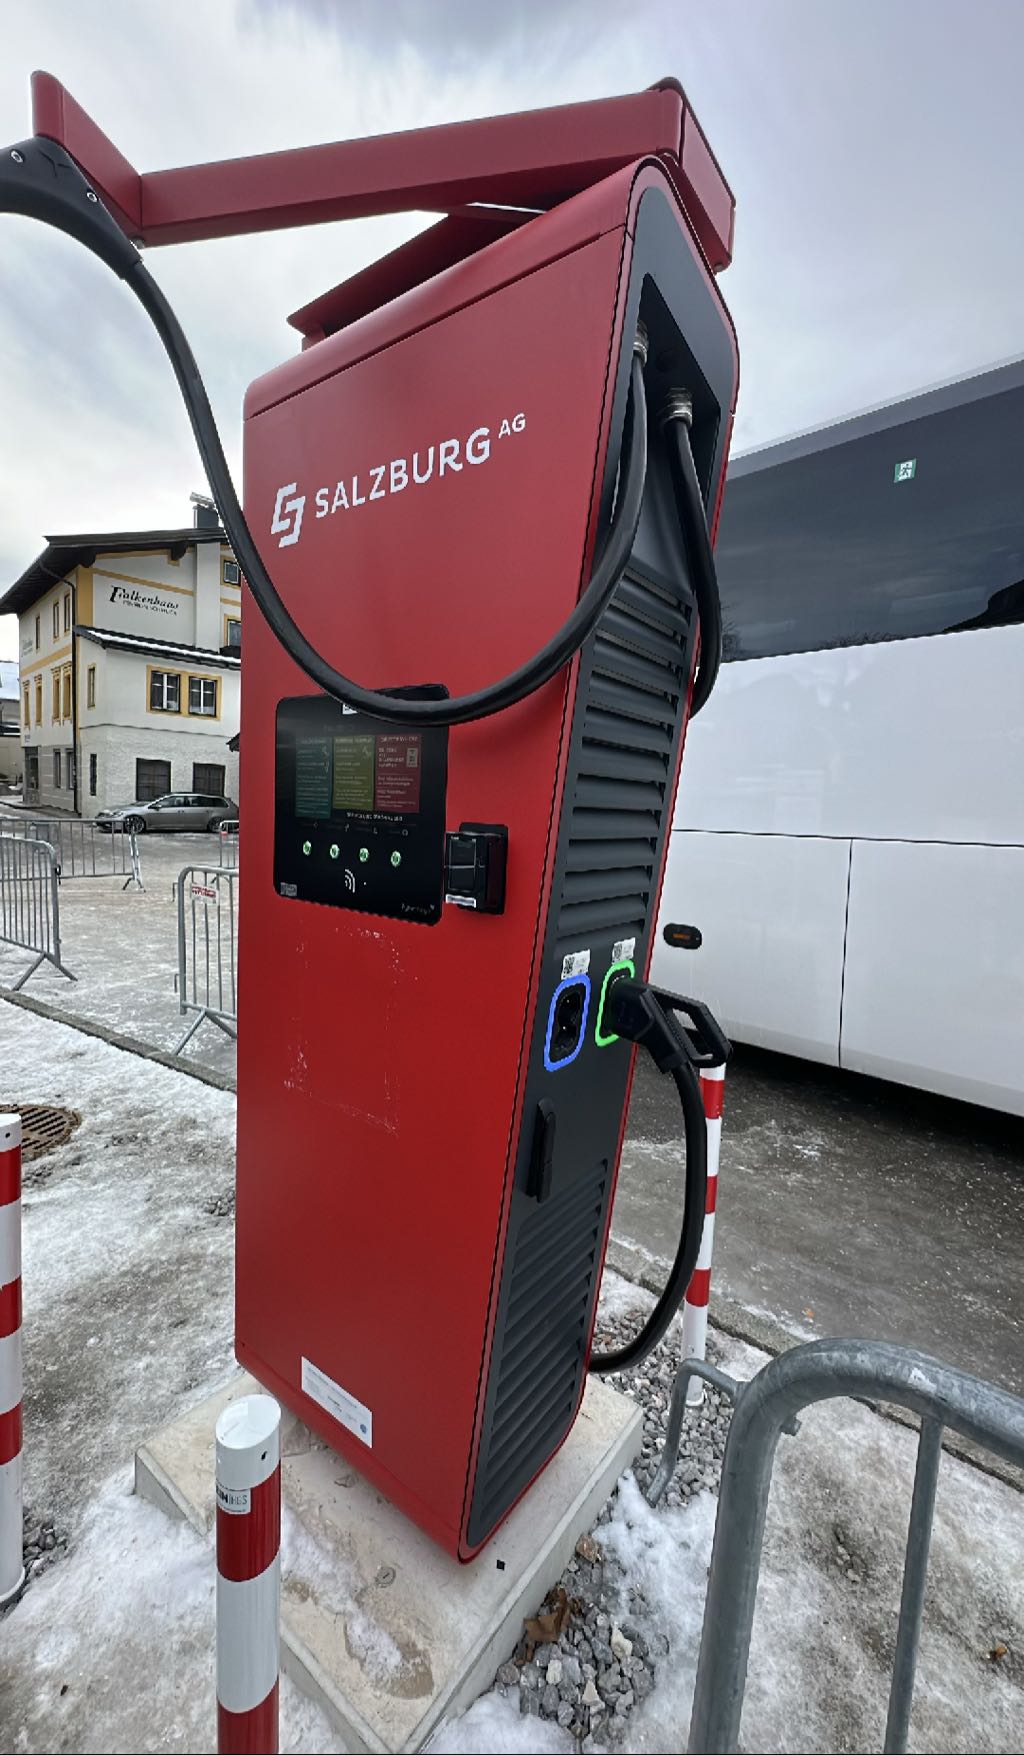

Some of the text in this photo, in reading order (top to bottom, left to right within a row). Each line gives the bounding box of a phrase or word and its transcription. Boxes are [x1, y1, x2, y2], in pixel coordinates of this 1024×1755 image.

[315, 412, 526, 518] SALZBURG AG
[109, 585, 179, 609] Falkenhaus
